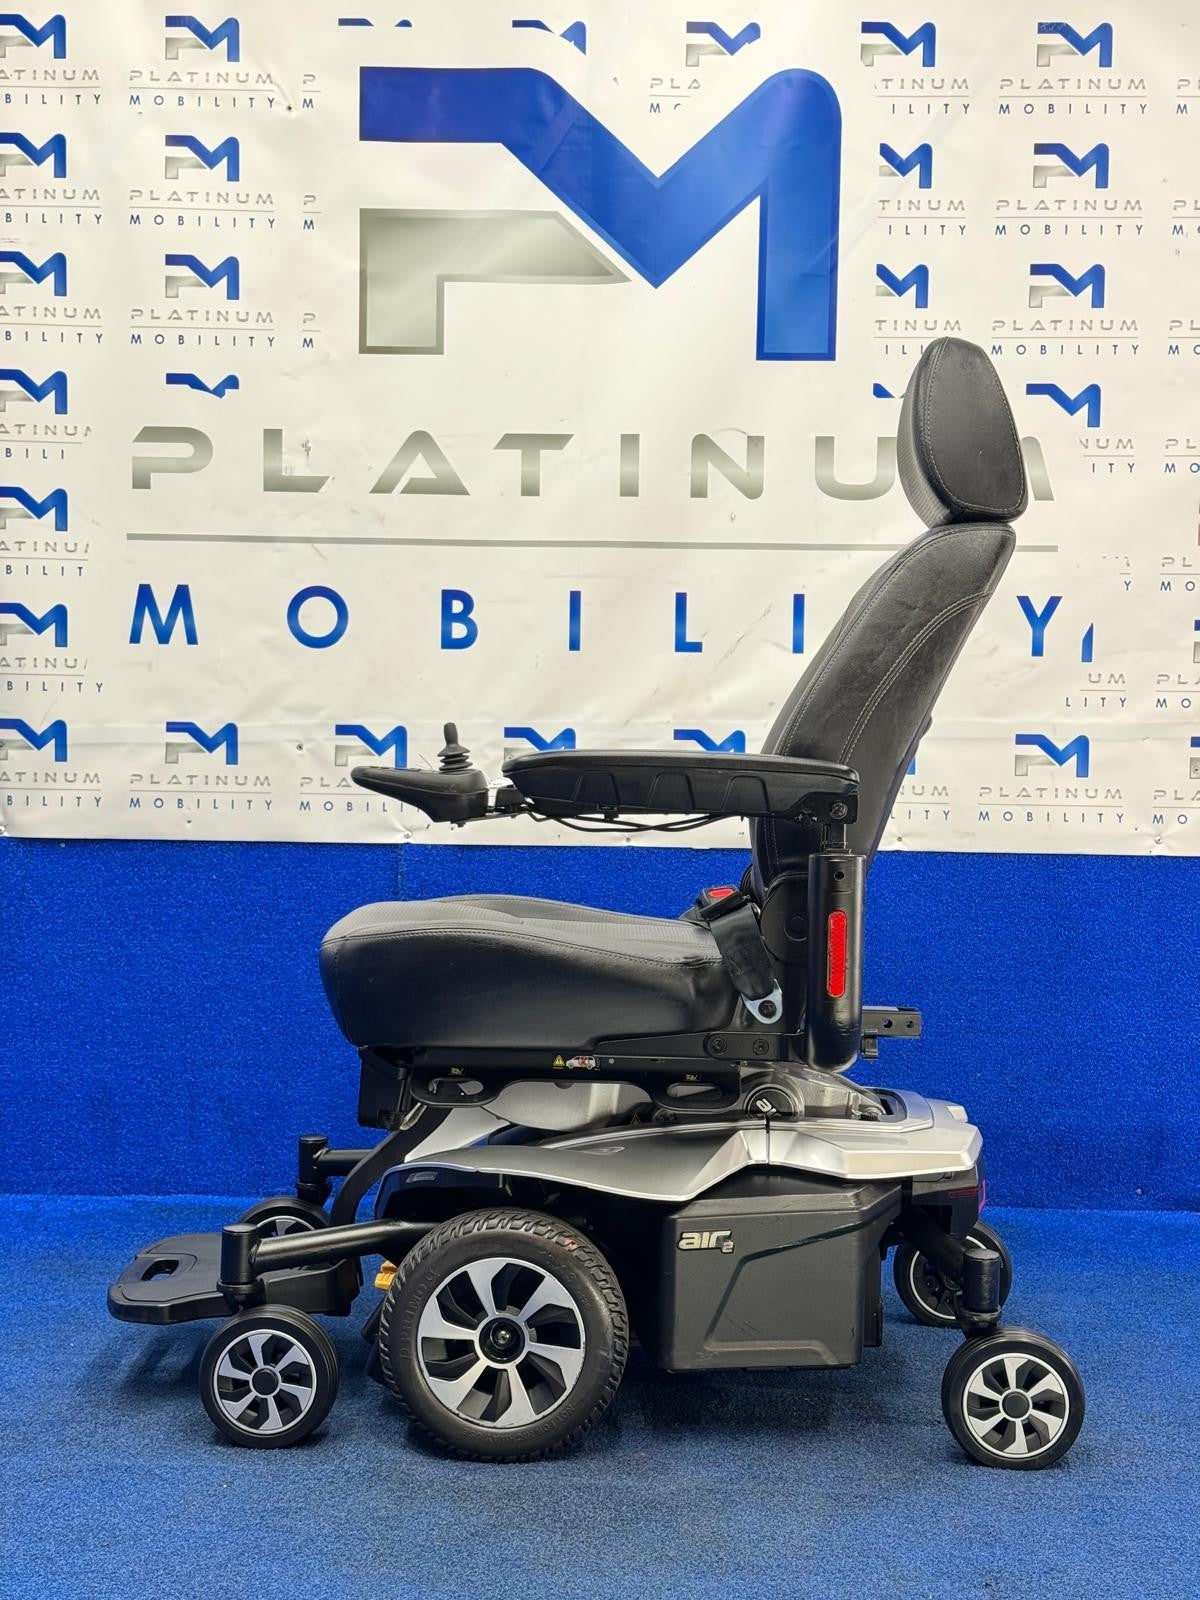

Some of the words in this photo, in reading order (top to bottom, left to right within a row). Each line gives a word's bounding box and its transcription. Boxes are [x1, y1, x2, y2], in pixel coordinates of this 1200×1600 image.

[0, 69, 99, 80] ATINUM
[129, 70, 274, 84] PLATINUM
[1000, 78, 1146, 90] PLATINUM
[5, 94, 101, 104] BILITY
[129, 95, 274, 108] MOBILITY
[892, 103, 969, 114] ILITY
[999, 104, 1147, 114] MOBILITY
[0, 188, 100, 200] ATINUM
[130, 190, 273, 205] PLATINUM
[878, 200, 965, 211] TINUM
[996, 200, 1142, 211] PLATINUM
[6, 213, 102, 224] BILITY
[130, 214, 275, 229] MOBILITY
[889, 225, 966, 235] ILITY
[995, 224, 1143, 235] MOBILITY
[0, 306, 101, 319] ATINUM
[131, 309, 273, 323] PLATINUM
[875, 320, 961, 331] TINUM
[992, 320, 1138, 331] PLATINUM
[5, 331, 102, 343] BILITY
[131, 334, 274, 347] MOBILITY
[992, 345, 1139, 355] MOBILITY
[133, 426, 1054, 501] PLATINU
[6, 565, 83, 576] BILIT
[129, 583, 1063, 657] MOBILIY
[7, 681, 102, 692] BILITY
[0, 771, 100, 783] ATINUM
[130, 774, 271, 786] PLATINUM
[979, 787, 1122, 799] PLATINUM
[6, 796, 102, 807] BILITY
[130, 798, 272, 810] MOBILITY
[300, 801, 420, 812] MOBILI
[979, 811, 1123, 823] MOBILITY
